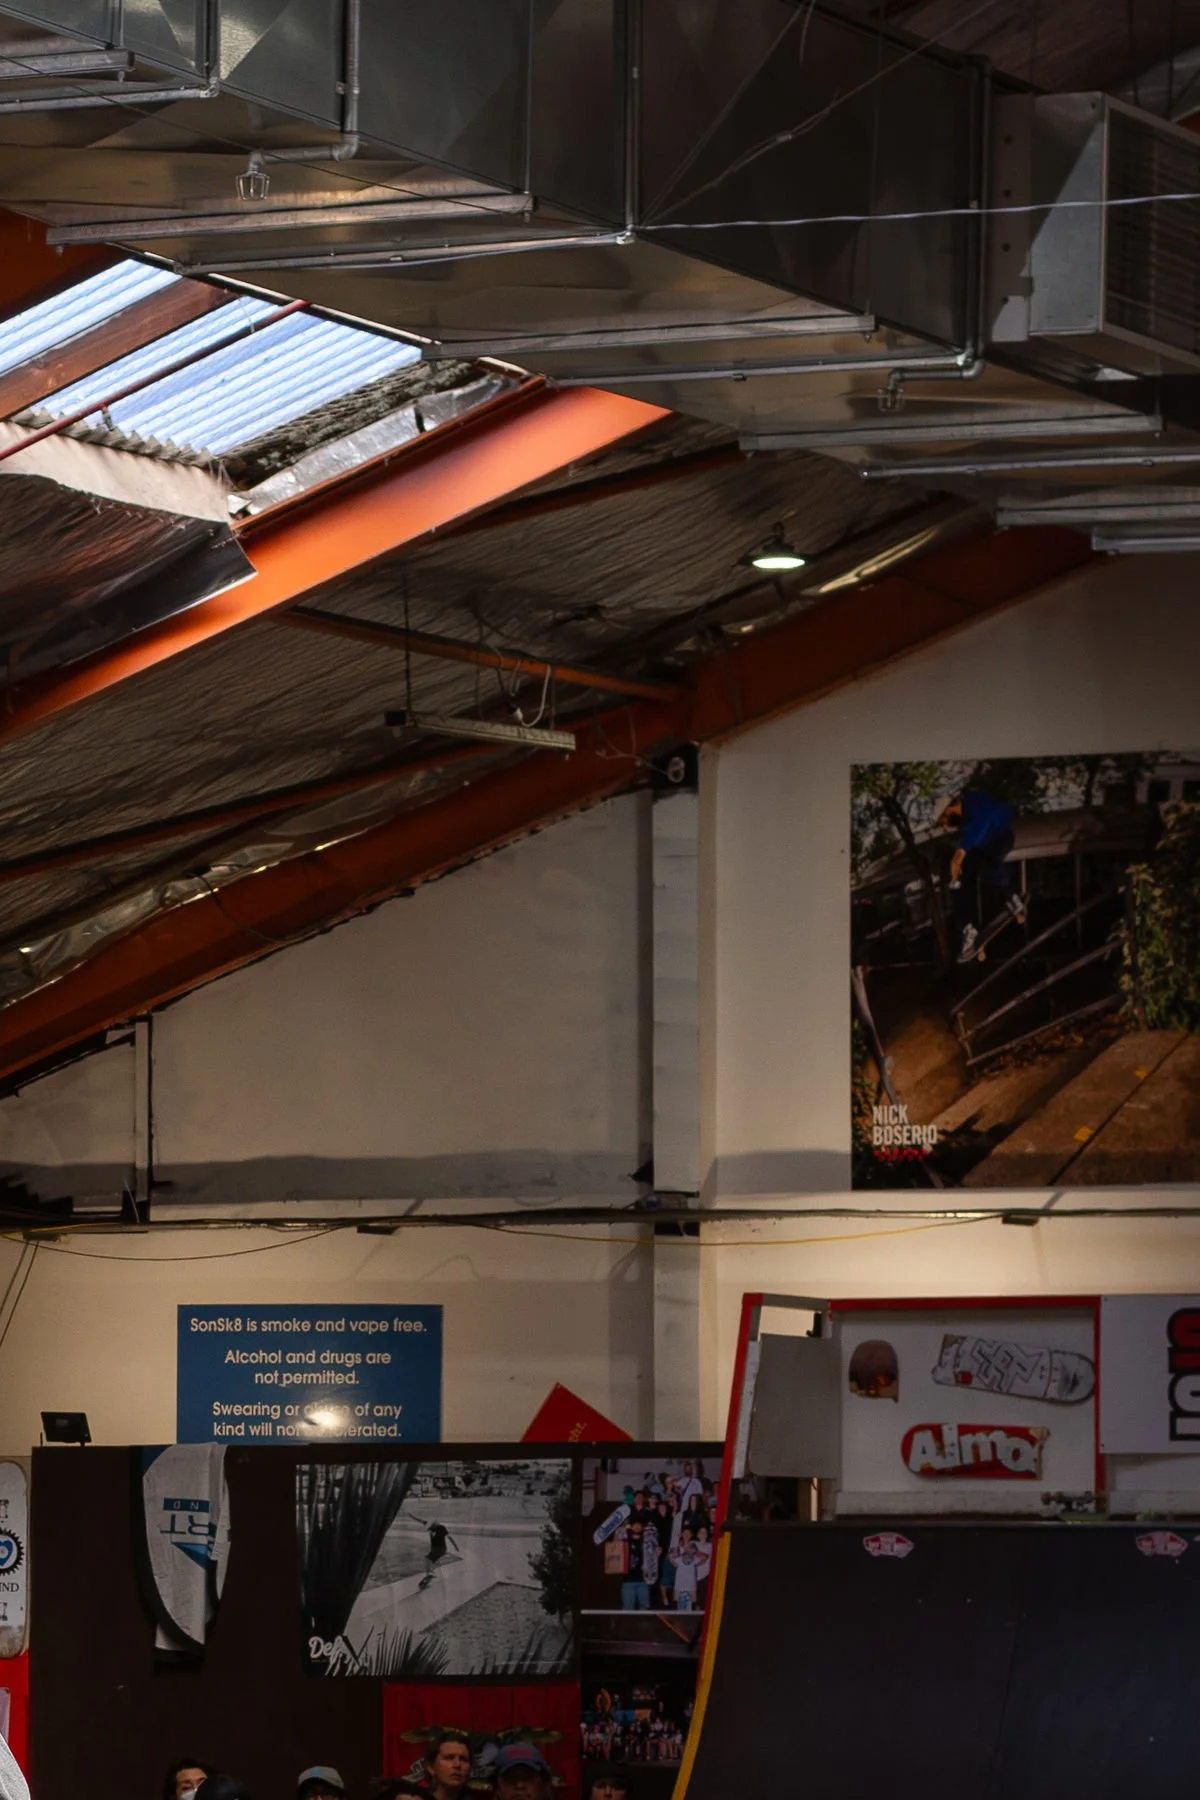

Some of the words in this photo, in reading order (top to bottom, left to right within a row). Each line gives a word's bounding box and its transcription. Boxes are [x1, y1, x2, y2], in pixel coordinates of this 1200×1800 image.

[872, 1104, 909, 1125] NICK
[872, 1125, 938, 1145] BOSERIO
[190, 1317, 242, 1332] SonSk8
[247, 1317, 257, 1332] is
[261, 1318, 311, 1332] smoke
[316, 1317, 345, 1332] and
[350, 1320, 389, 1335] vape
[393, 1317, 428, 1332] free.
[224, 1349, 281, 1364] Alcohol
[286, 1349, 316, 1364] and
[320, 1349, 362, 1367] drugs
[366, 1352, 392, 1364] are
[255, 1371, 279, 1384] not
[282, 1370, 359, 1387] permitted.
[212, 1402, 280, 1419] Swearing
[285, 1405, 300, 1416] or
[354, 1402, 370, 1416] of
[374, 1406, 402, 1419] any
[213, 1422, 245, 1436] kind
[249, 1422, 273, 1436] will
